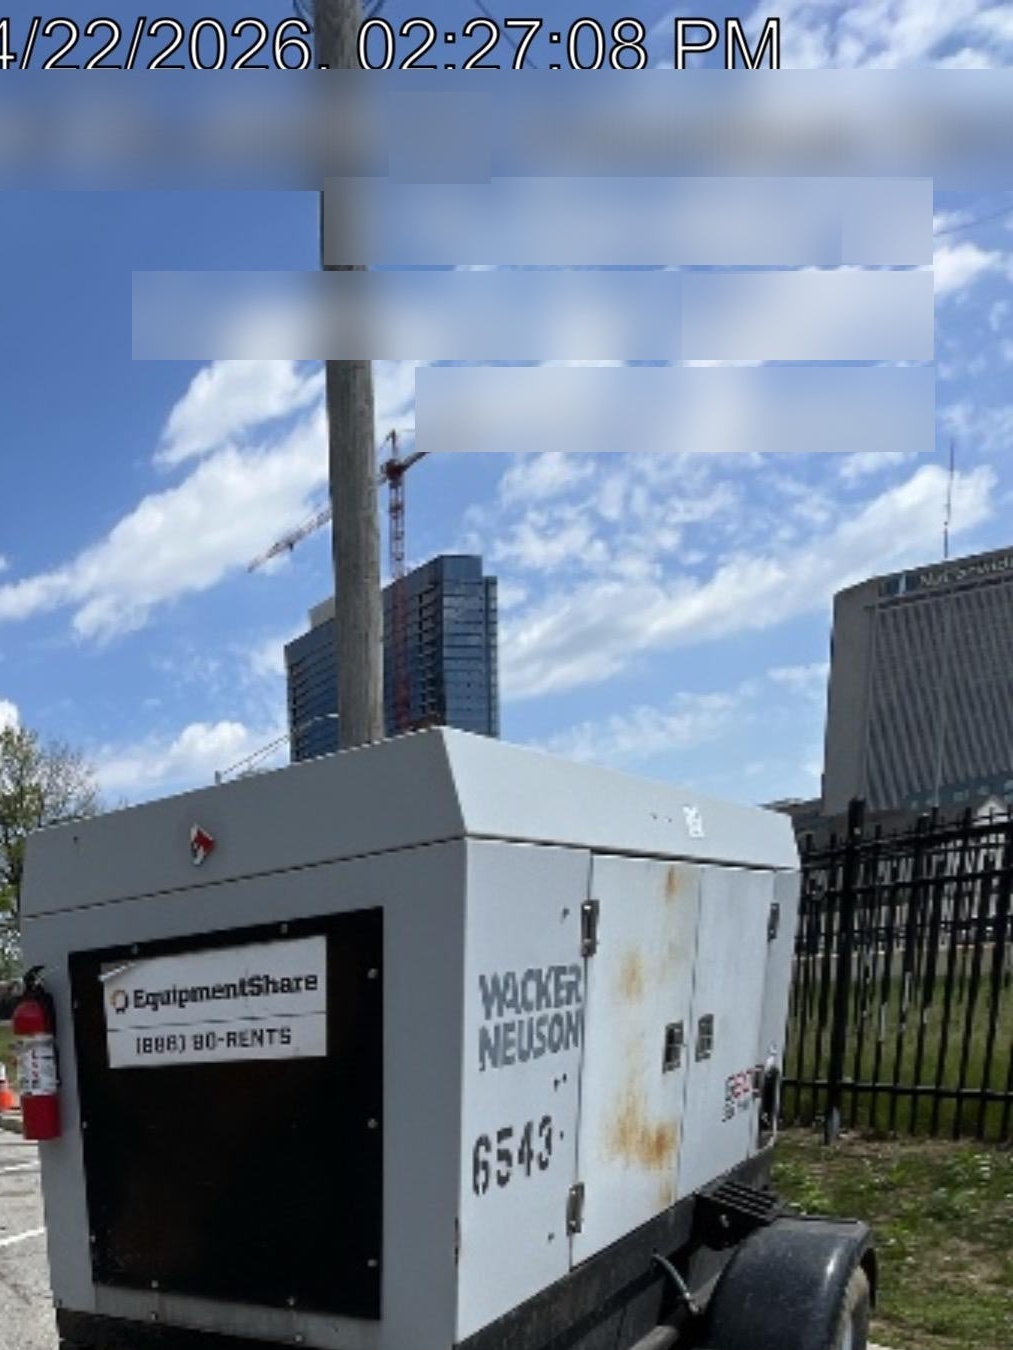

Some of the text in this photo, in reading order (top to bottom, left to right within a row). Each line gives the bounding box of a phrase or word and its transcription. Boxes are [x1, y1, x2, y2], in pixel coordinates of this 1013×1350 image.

[133, 974, 318, 1011] EquipmentShare
[478, 964, 583, 1021] WACKER
[192, 1027, 292, 1051] 80-RENTS
[478, 1007, 585, 1072] NEUSON
[472, 1115, 553, 1196] 6543
